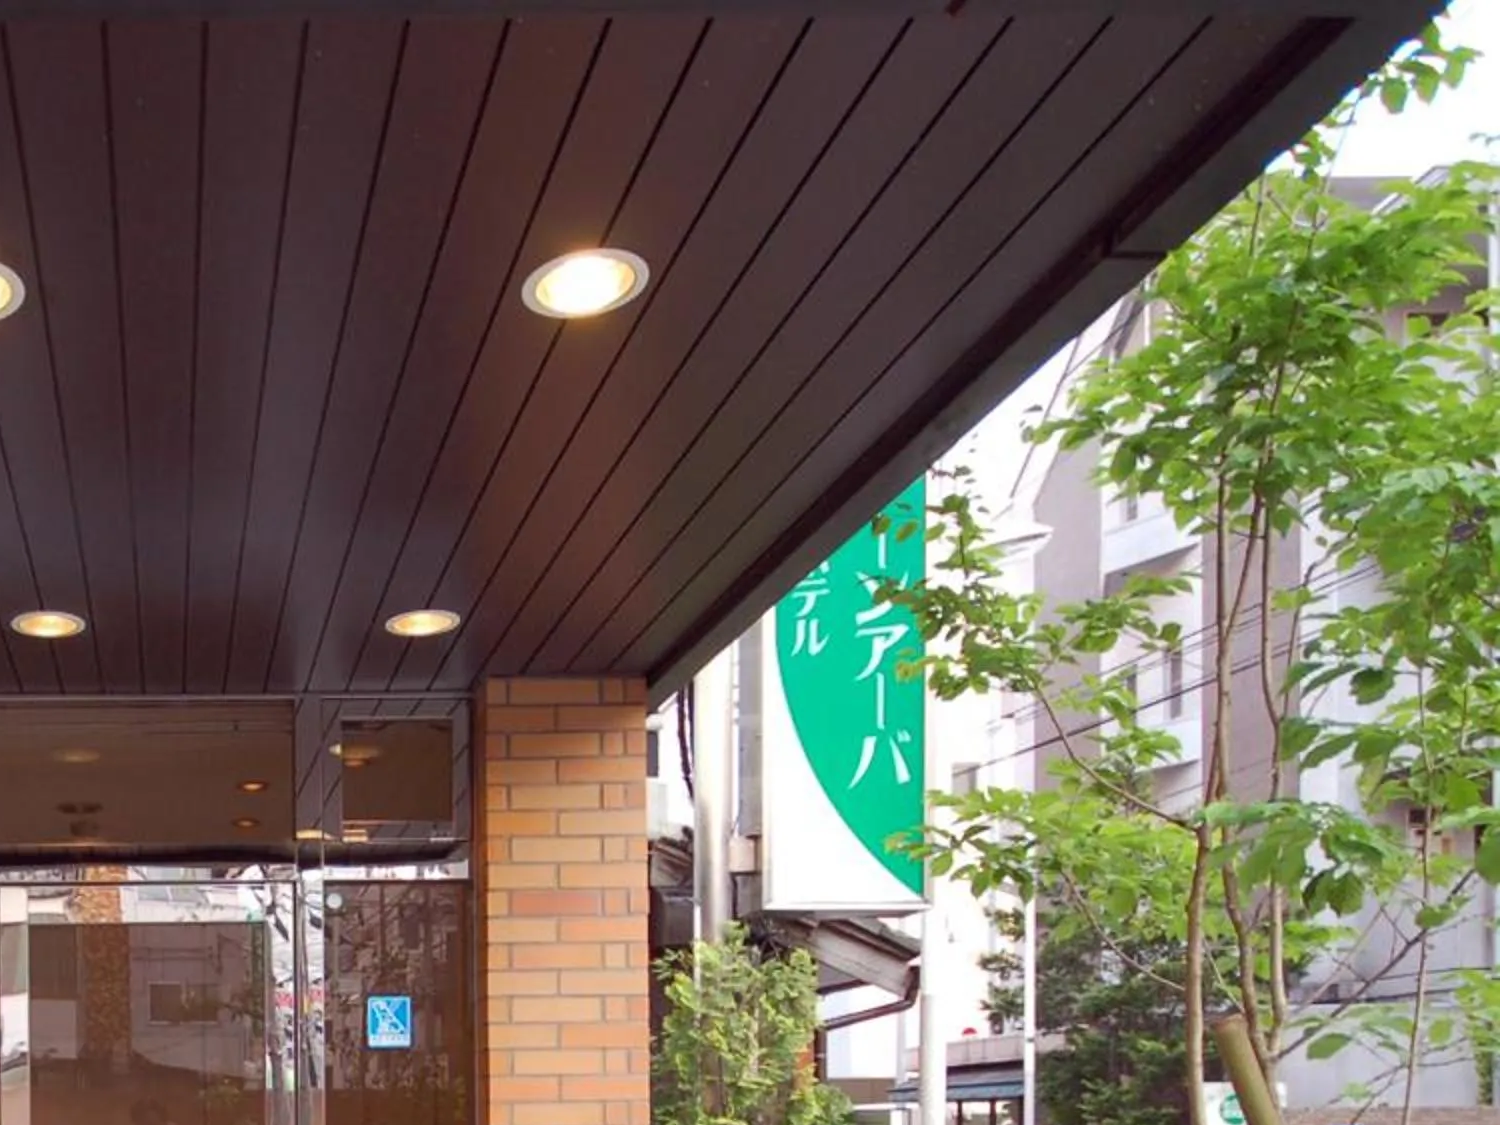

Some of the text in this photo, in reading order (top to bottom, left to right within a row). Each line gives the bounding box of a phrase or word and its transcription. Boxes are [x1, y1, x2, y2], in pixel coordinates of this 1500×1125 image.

[847, 513, 912, 789] ーンアーバ
